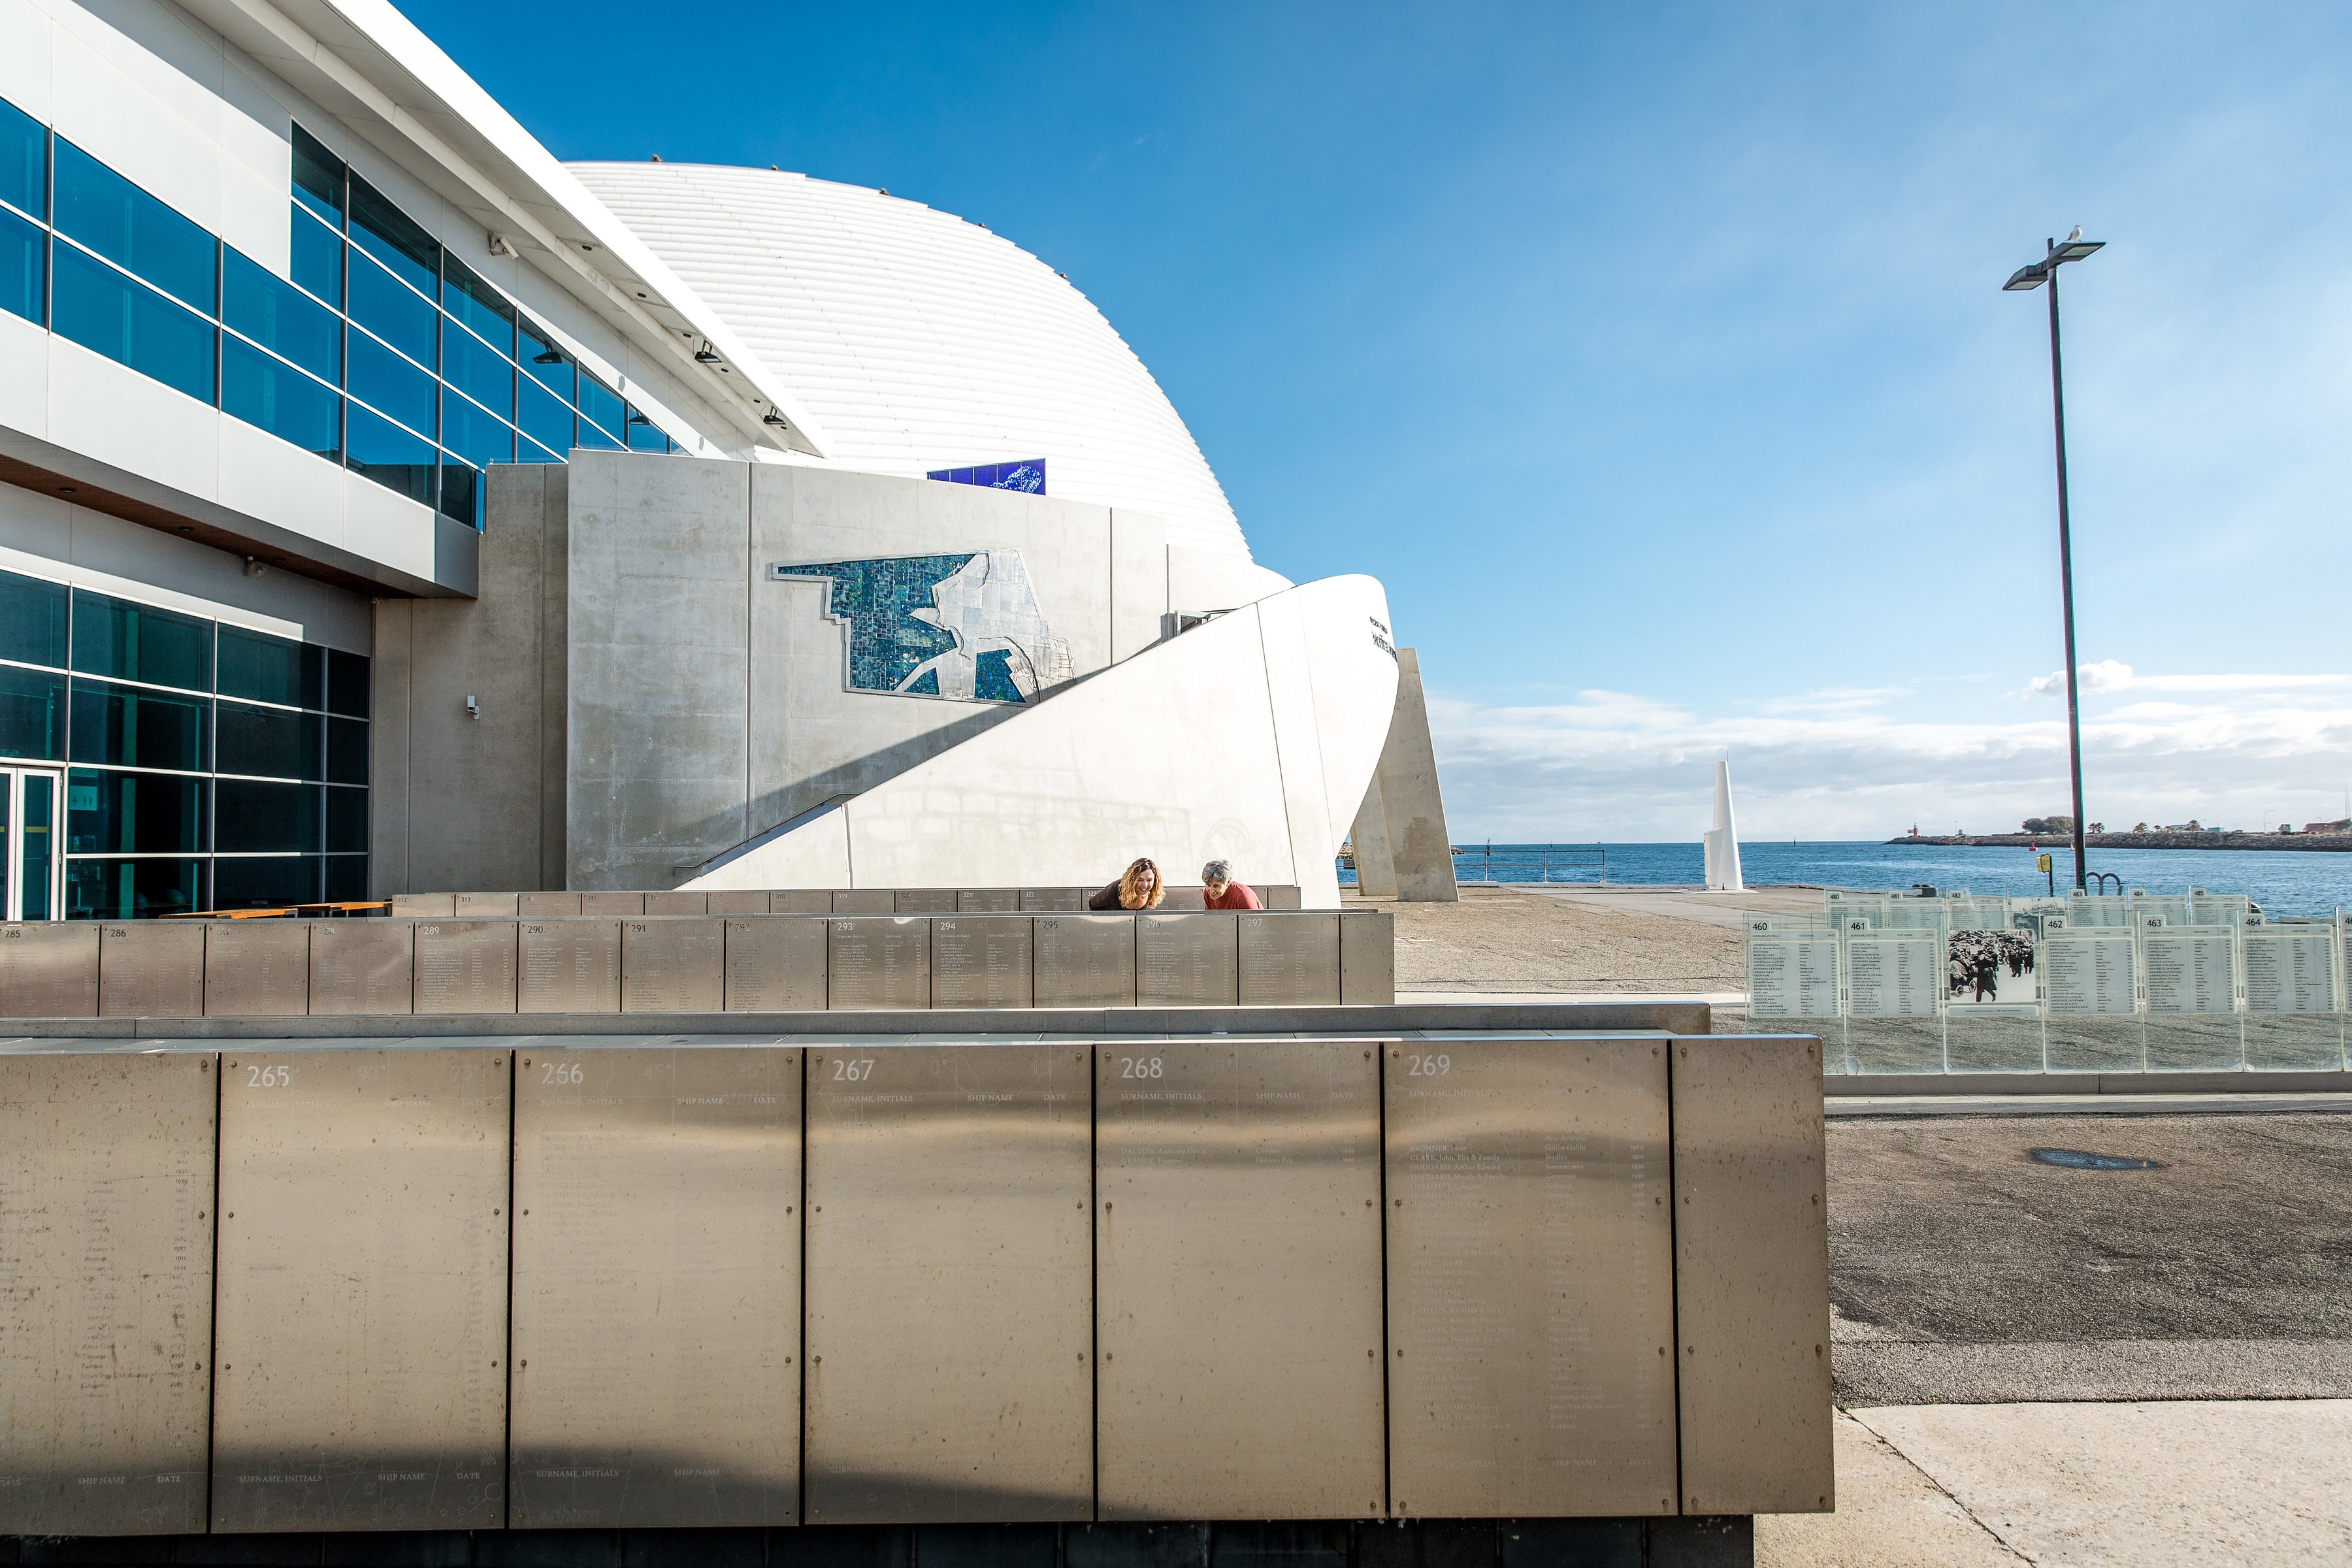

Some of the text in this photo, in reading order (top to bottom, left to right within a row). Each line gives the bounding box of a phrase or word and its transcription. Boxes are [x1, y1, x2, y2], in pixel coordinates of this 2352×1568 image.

[542, 1062, 584, 1084] 266
[833, 1060, 875, 1081] 267
[1121, 1057, 1162, 1079] 268
[1409, 1054, 1450, 1076] 269
[247, 1066, 290, 1087] 265
